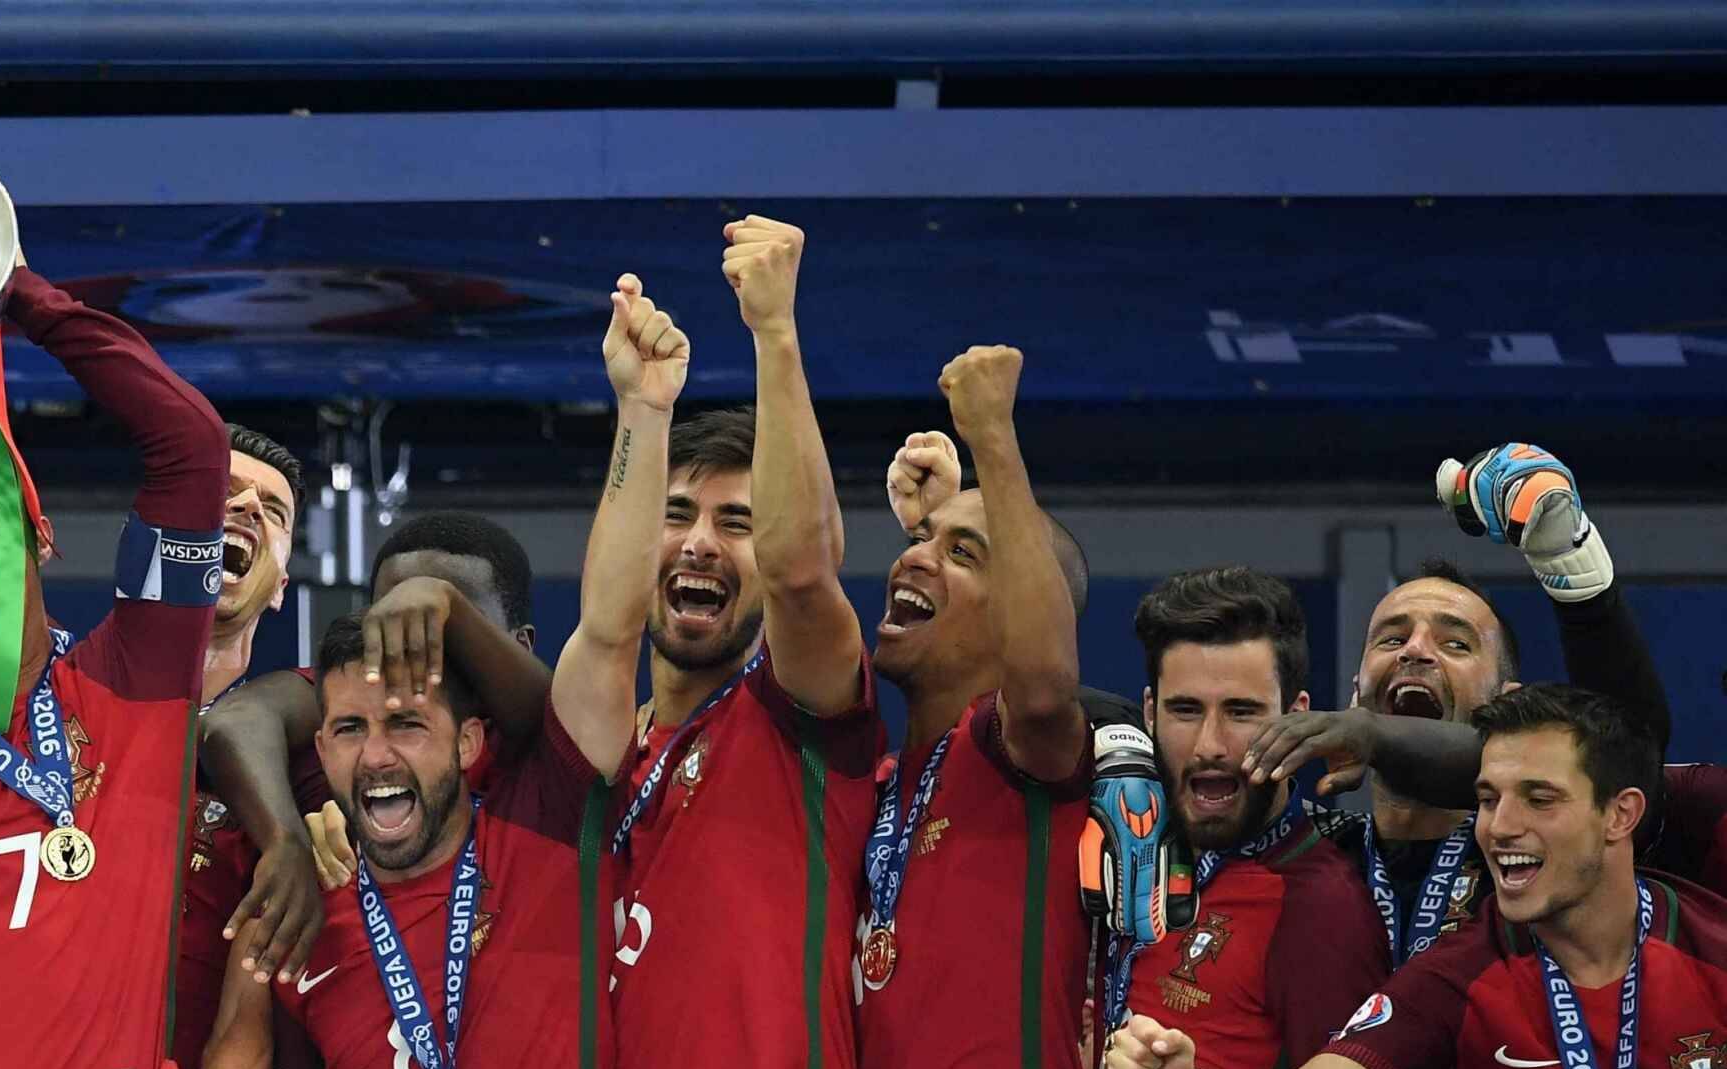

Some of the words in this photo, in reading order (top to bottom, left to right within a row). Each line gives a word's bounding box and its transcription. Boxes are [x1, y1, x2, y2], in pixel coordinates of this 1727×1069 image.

[161, 542, 219, 559] RACISM
[33, 700, 62, 756] 2016
[1109, 733, 1150, 746] ARDO
[1239, 820, 1292, 857] 2016
[362, 890, 398, 957] EURO
[449, 885, 474, 953] EURO
[1415, 871, 1454, 929] UEFA
[384, 954, 422, 1020] UEFA
[446, 959, 464, 1024] 2016
[1550, 978, 1584, 1044] EURO
